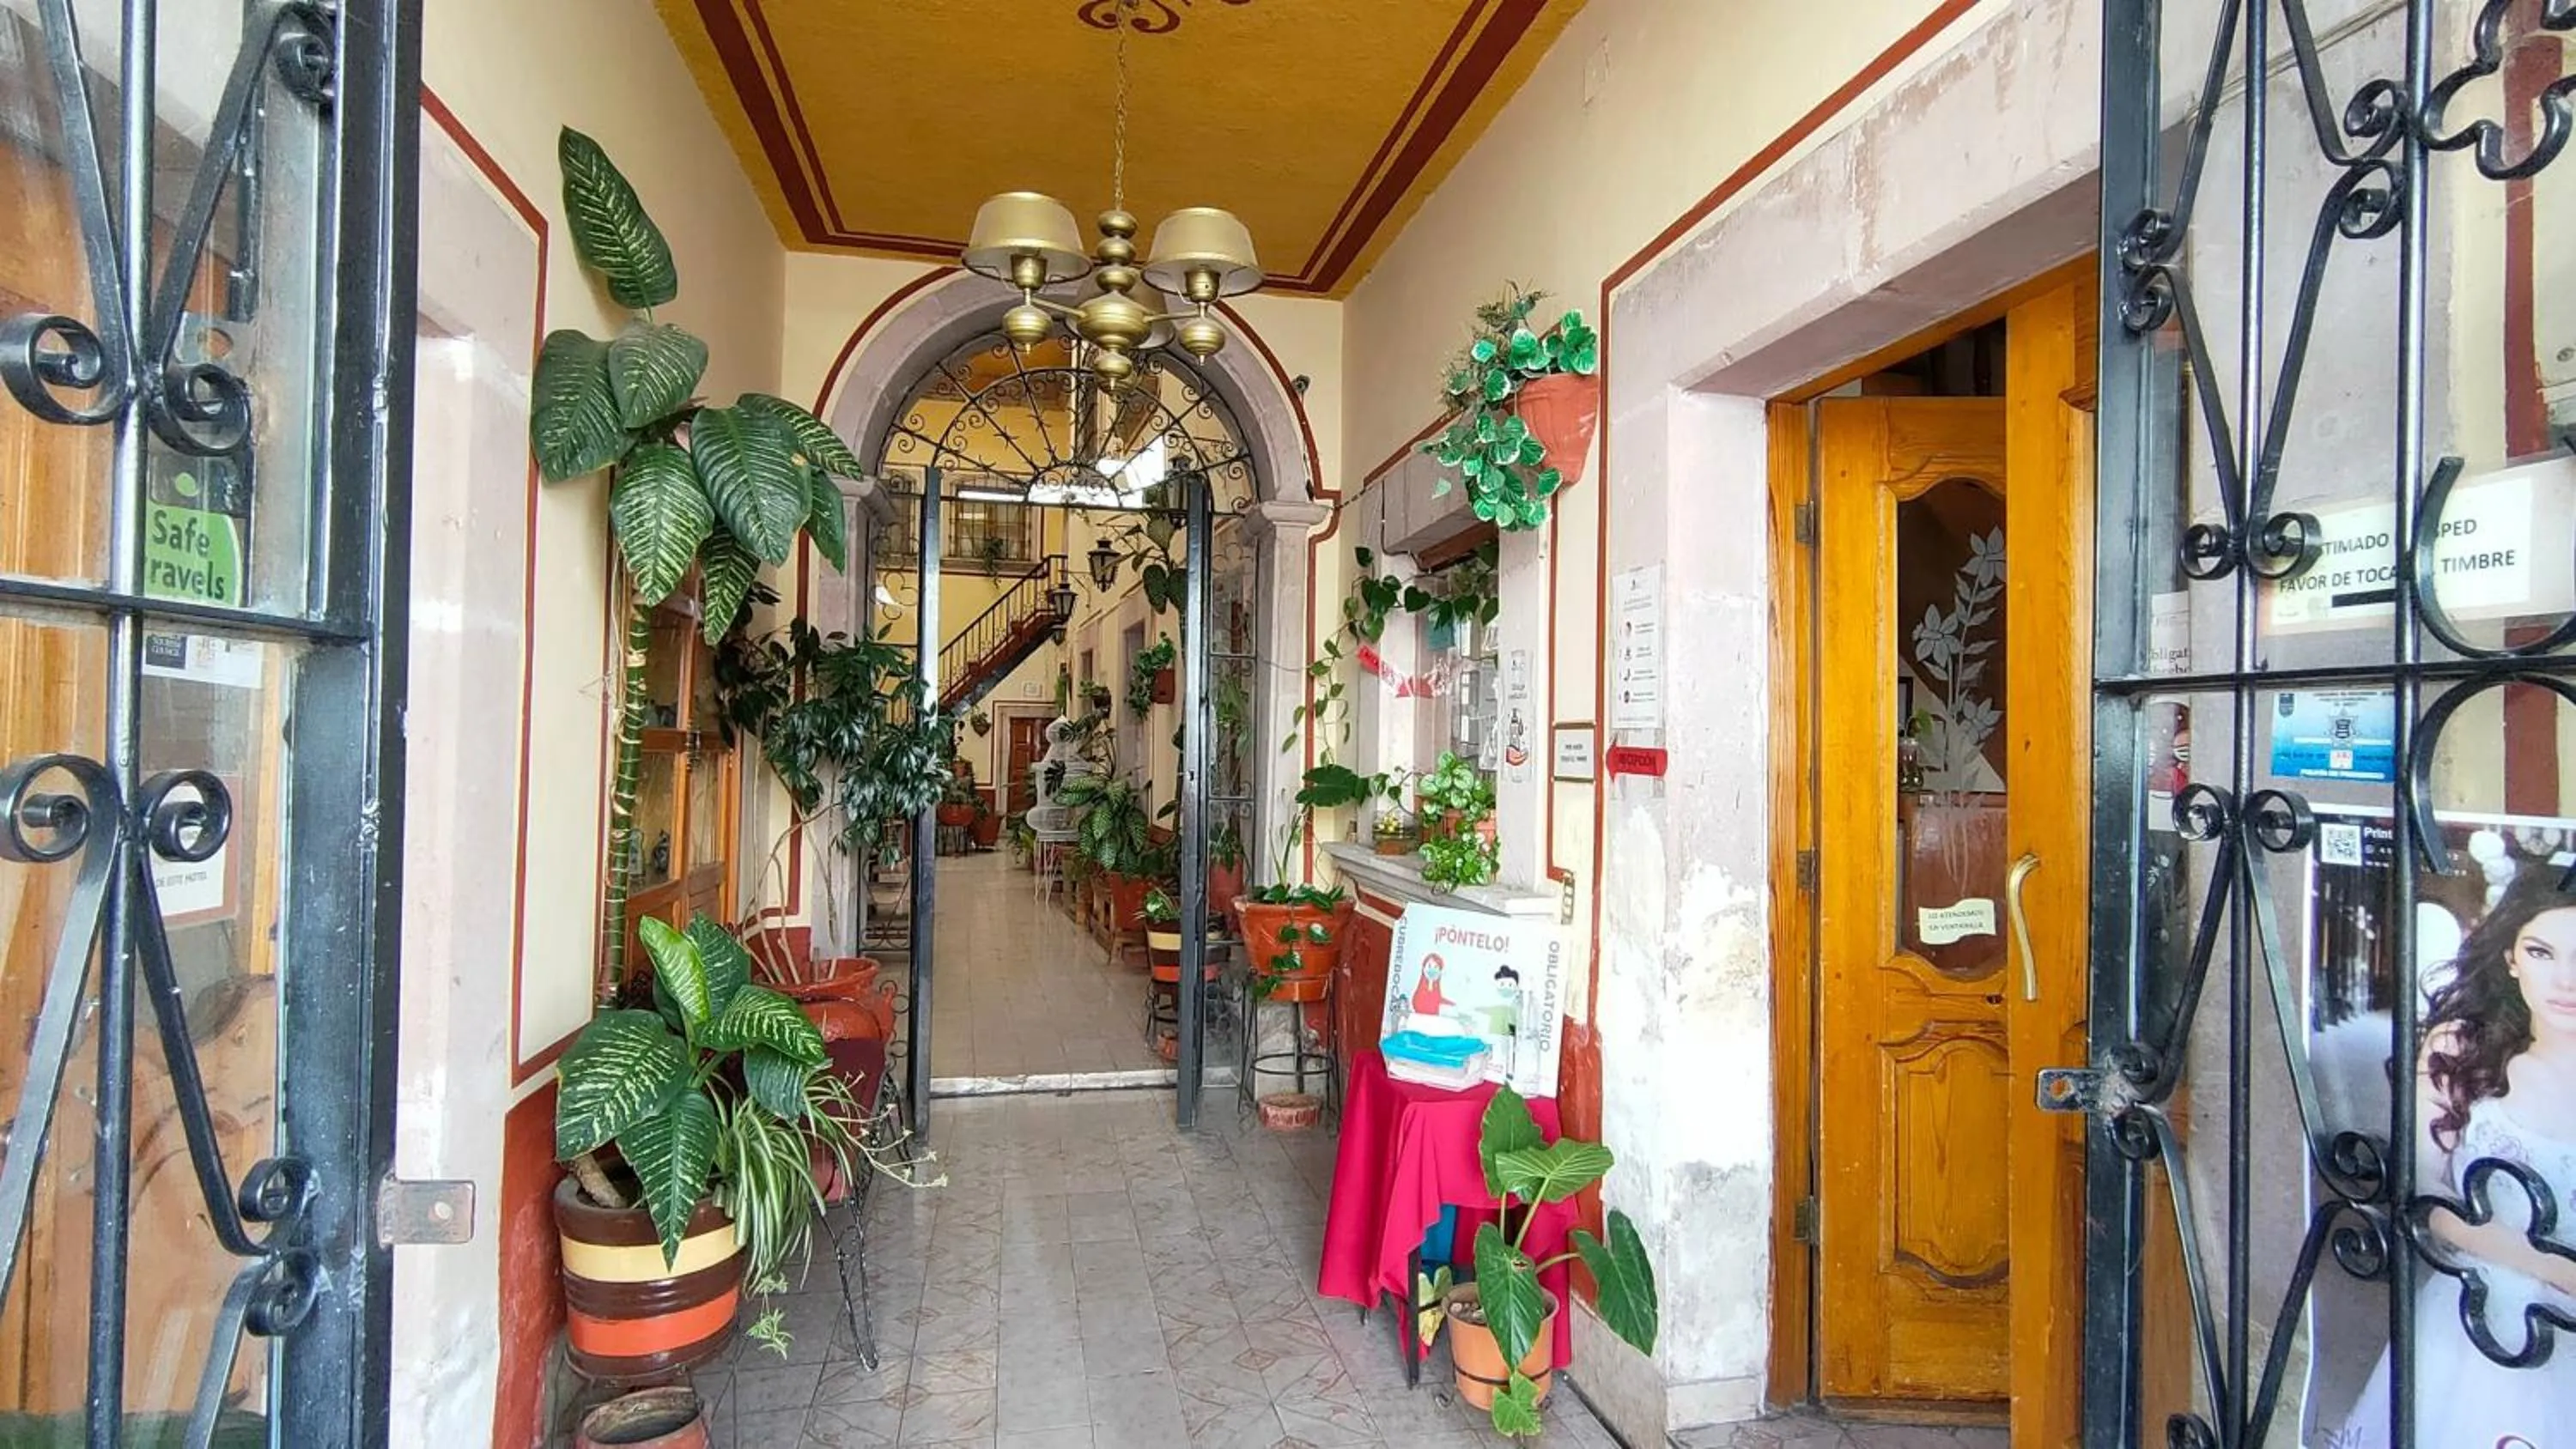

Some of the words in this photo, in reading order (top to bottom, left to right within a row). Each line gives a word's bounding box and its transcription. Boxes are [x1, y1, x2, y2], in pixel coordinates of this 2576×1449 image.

[152, 509, 210, 557] Safe
[2320, 533, 2390, 555] TIMADO
[147, 557, 226, 600] ravels
[2280, 575, 2327, 593] FAVOR
[2332, 572, 2351, 587] DE
[2356, 567, 2397, 583] TOCA
[2441, 549, 2516, 573] TIMBRE
[1539, 940, 1560, 1053] OBLIGATORIO
